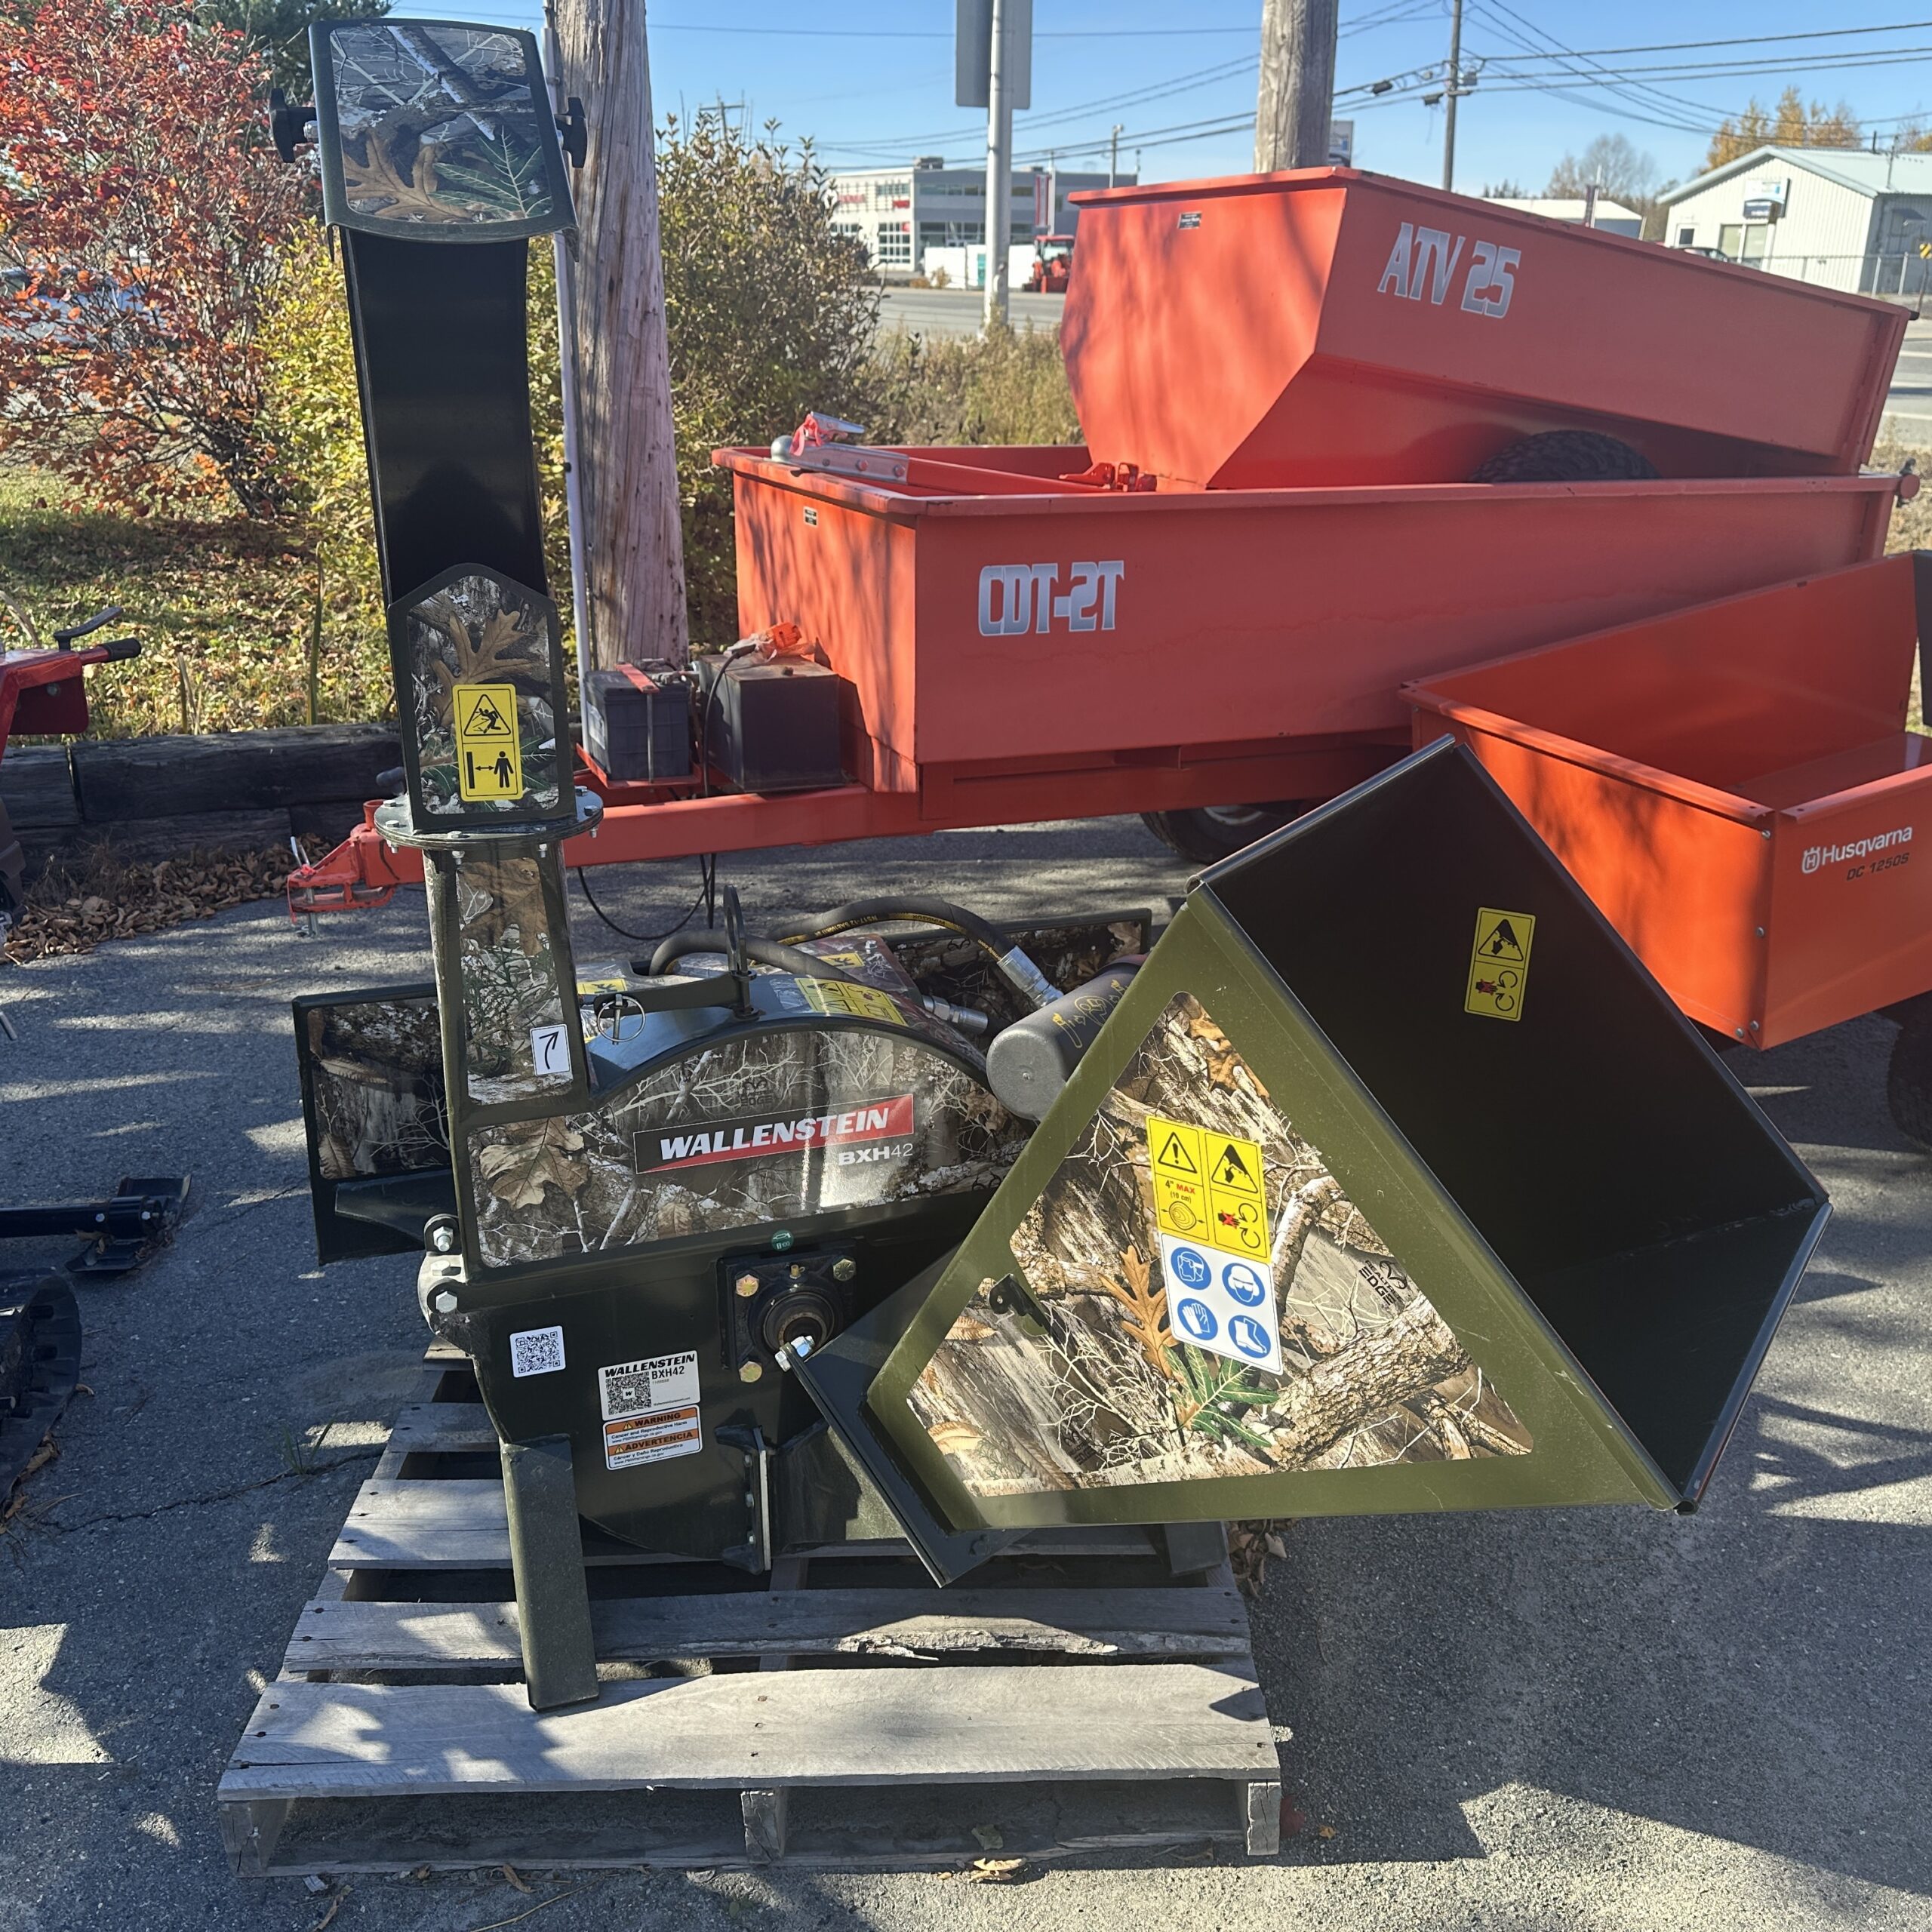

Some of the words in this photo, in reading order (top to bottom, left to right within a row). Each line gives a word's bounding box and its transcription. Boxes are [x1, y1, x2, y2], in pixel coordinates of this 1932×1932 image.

[1378, 222, 1466, 305] ATV
[1460, 241, 1522, 318] 25
[978, 560, 1124, 636] CDT-2T
[1822, 826, 1913, 866] Husqvarna
[1846, 866, 1866, 881] DC
[660, 1107, 889, 1161] WALLENSTEIN
[838, 1143, 913, 1166] BXH42
[1165, 1180, 1174, 1189] 4"
[1176, 1183, 1195, 1195] MAX
[1358, 1266, 1396, 1306] EDGE
[605, 1353, 695, 1377] WALLENSTEIN
[651, 1365, 685, 1380] BXH42
[634, 1412, 681, 1426] WARNING
[641, 1424, 673, 1434] Reproductive
[625, 1432, 693, 1451] ADVERTENCIA
